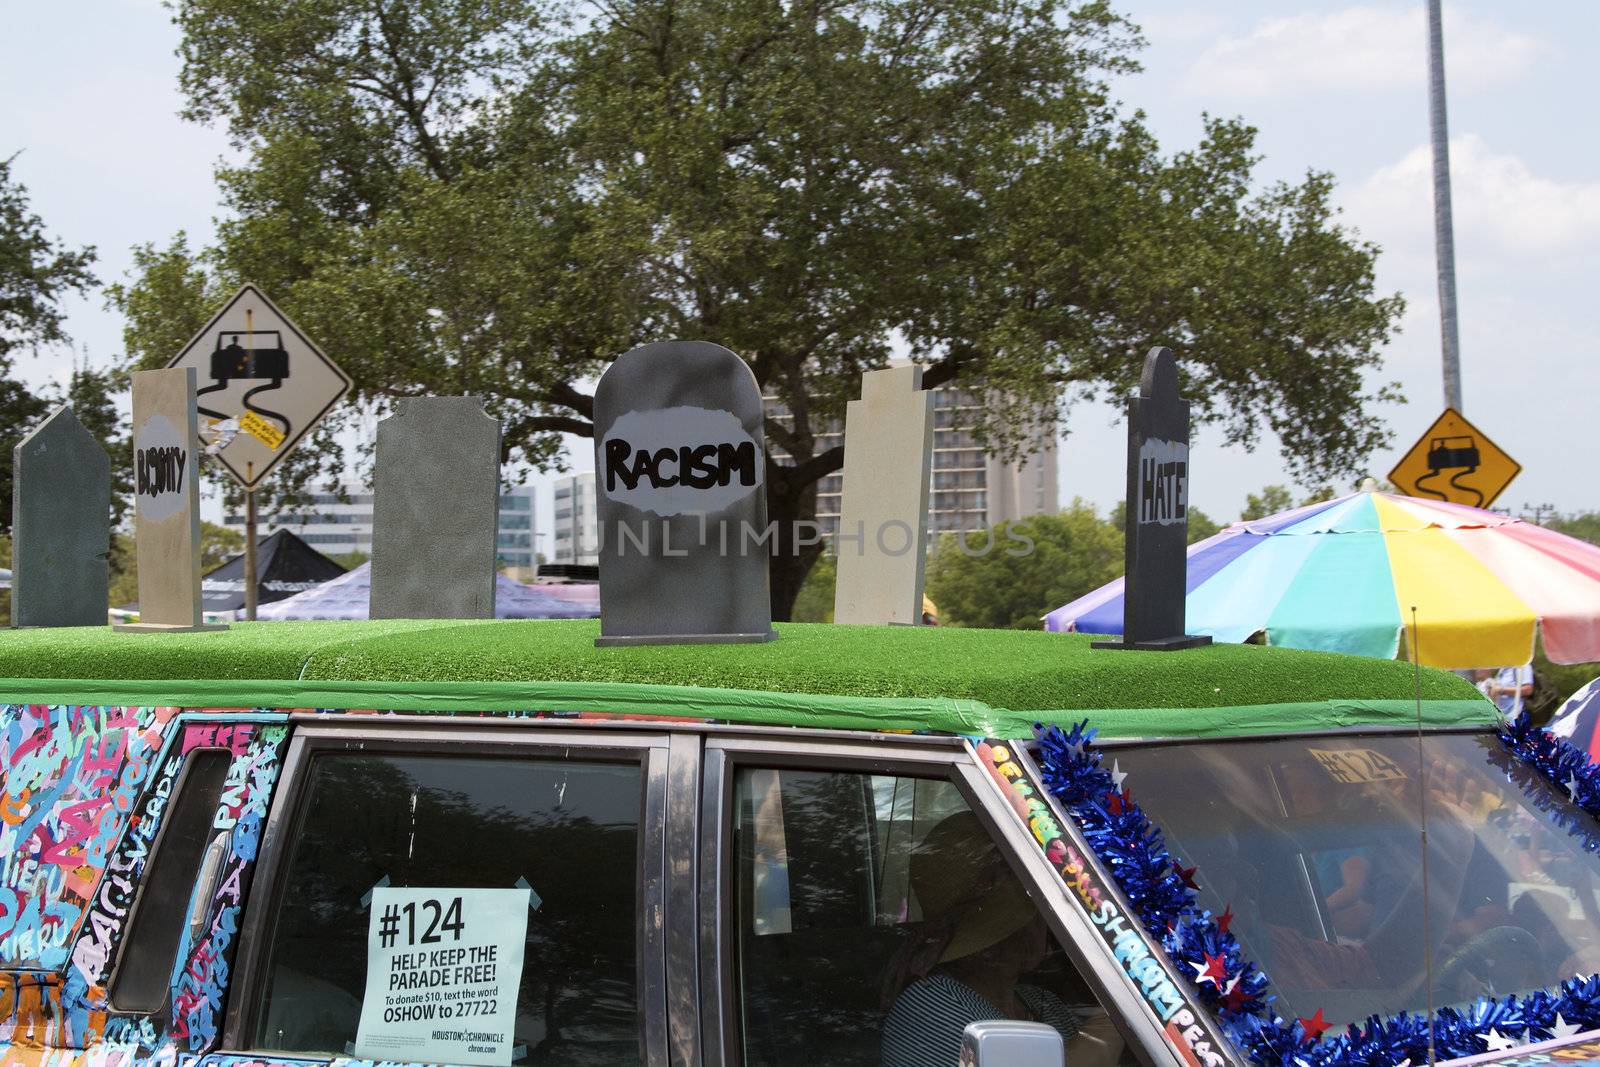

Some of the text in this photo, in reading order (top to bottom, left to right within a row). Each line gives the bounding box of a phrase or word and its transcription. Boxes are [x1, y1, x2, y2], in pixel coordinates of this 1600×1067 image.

[605, 438, 756, 492] RACISM
[1141, 457, 1186, 522] HATE
[1316, 750, 1402, 783] #124
[379, 897, 465, 949] #124
[391, 945, 498, 972] HELP KEEP THE
[1090, 899, 1186, 1022] SHALOM
[389, 964, 496, 991] PARADE FREE!
[385, 986, 498, 1006] To donate $10, text the word
[383, 1000, 497, 1023] OSHOW to 27722
[431, 1030, 462, 1041] HOUSTON
[468, 1031, 504, 1043] CHRONICLE
[467, 1045, 497, 1054] chron.com
